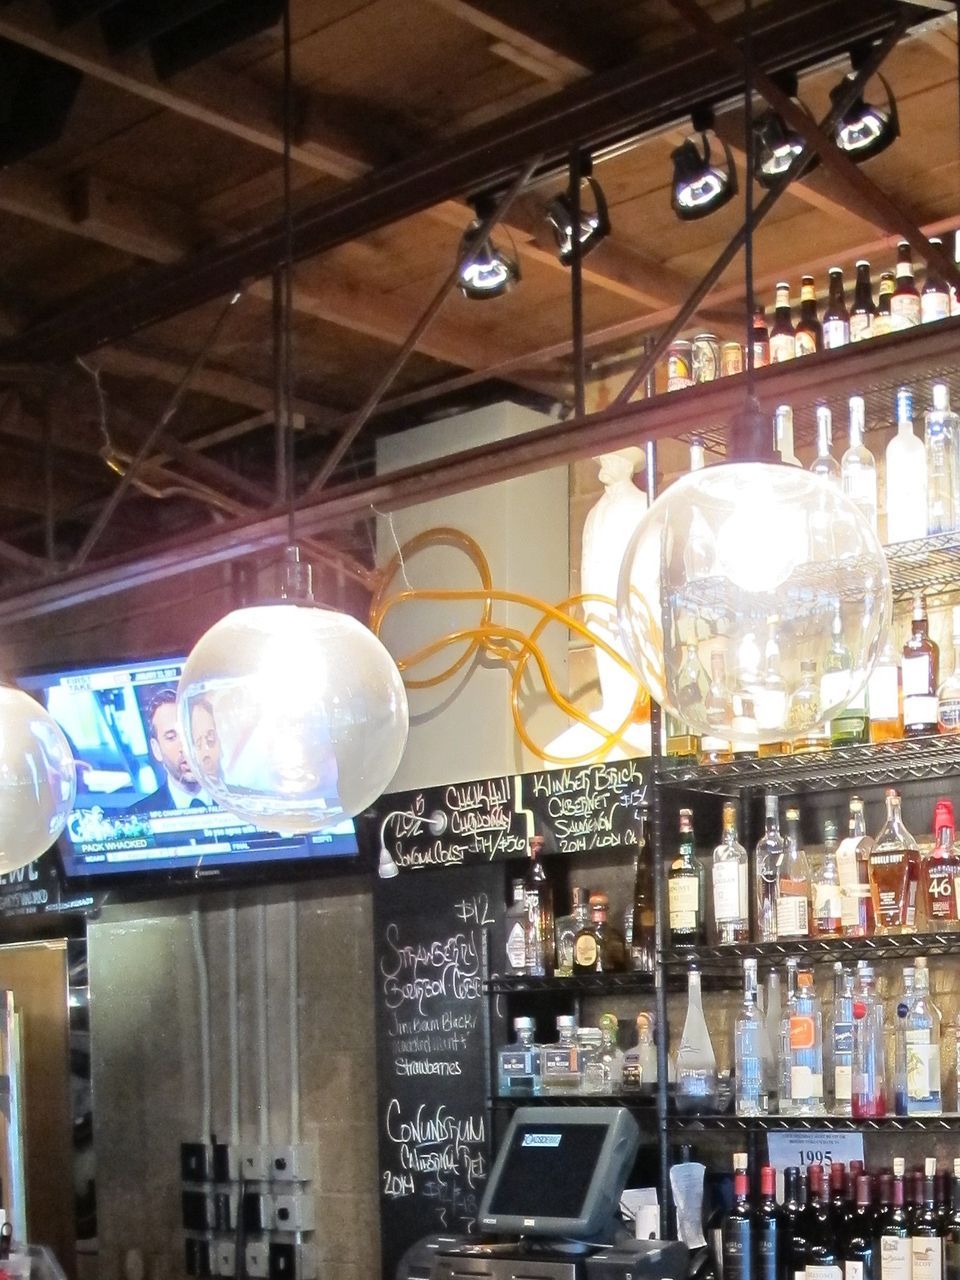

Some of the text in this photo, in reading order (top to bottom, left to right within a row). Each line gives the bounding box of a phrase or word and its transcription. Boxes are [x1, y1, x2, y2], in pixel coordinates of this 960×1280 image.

[81, 839, 148, 853] PACK WHACKED
[560, 837, 587, 853] 2014
[929, 878, 952, 899] 46
[454, 893, 495, 923] $12
[386, 1098, 486, 1147] CONUNDRUM
[798, 1149, 833, 1167] 1995
[383, 1170, 416, 1199] 2014
